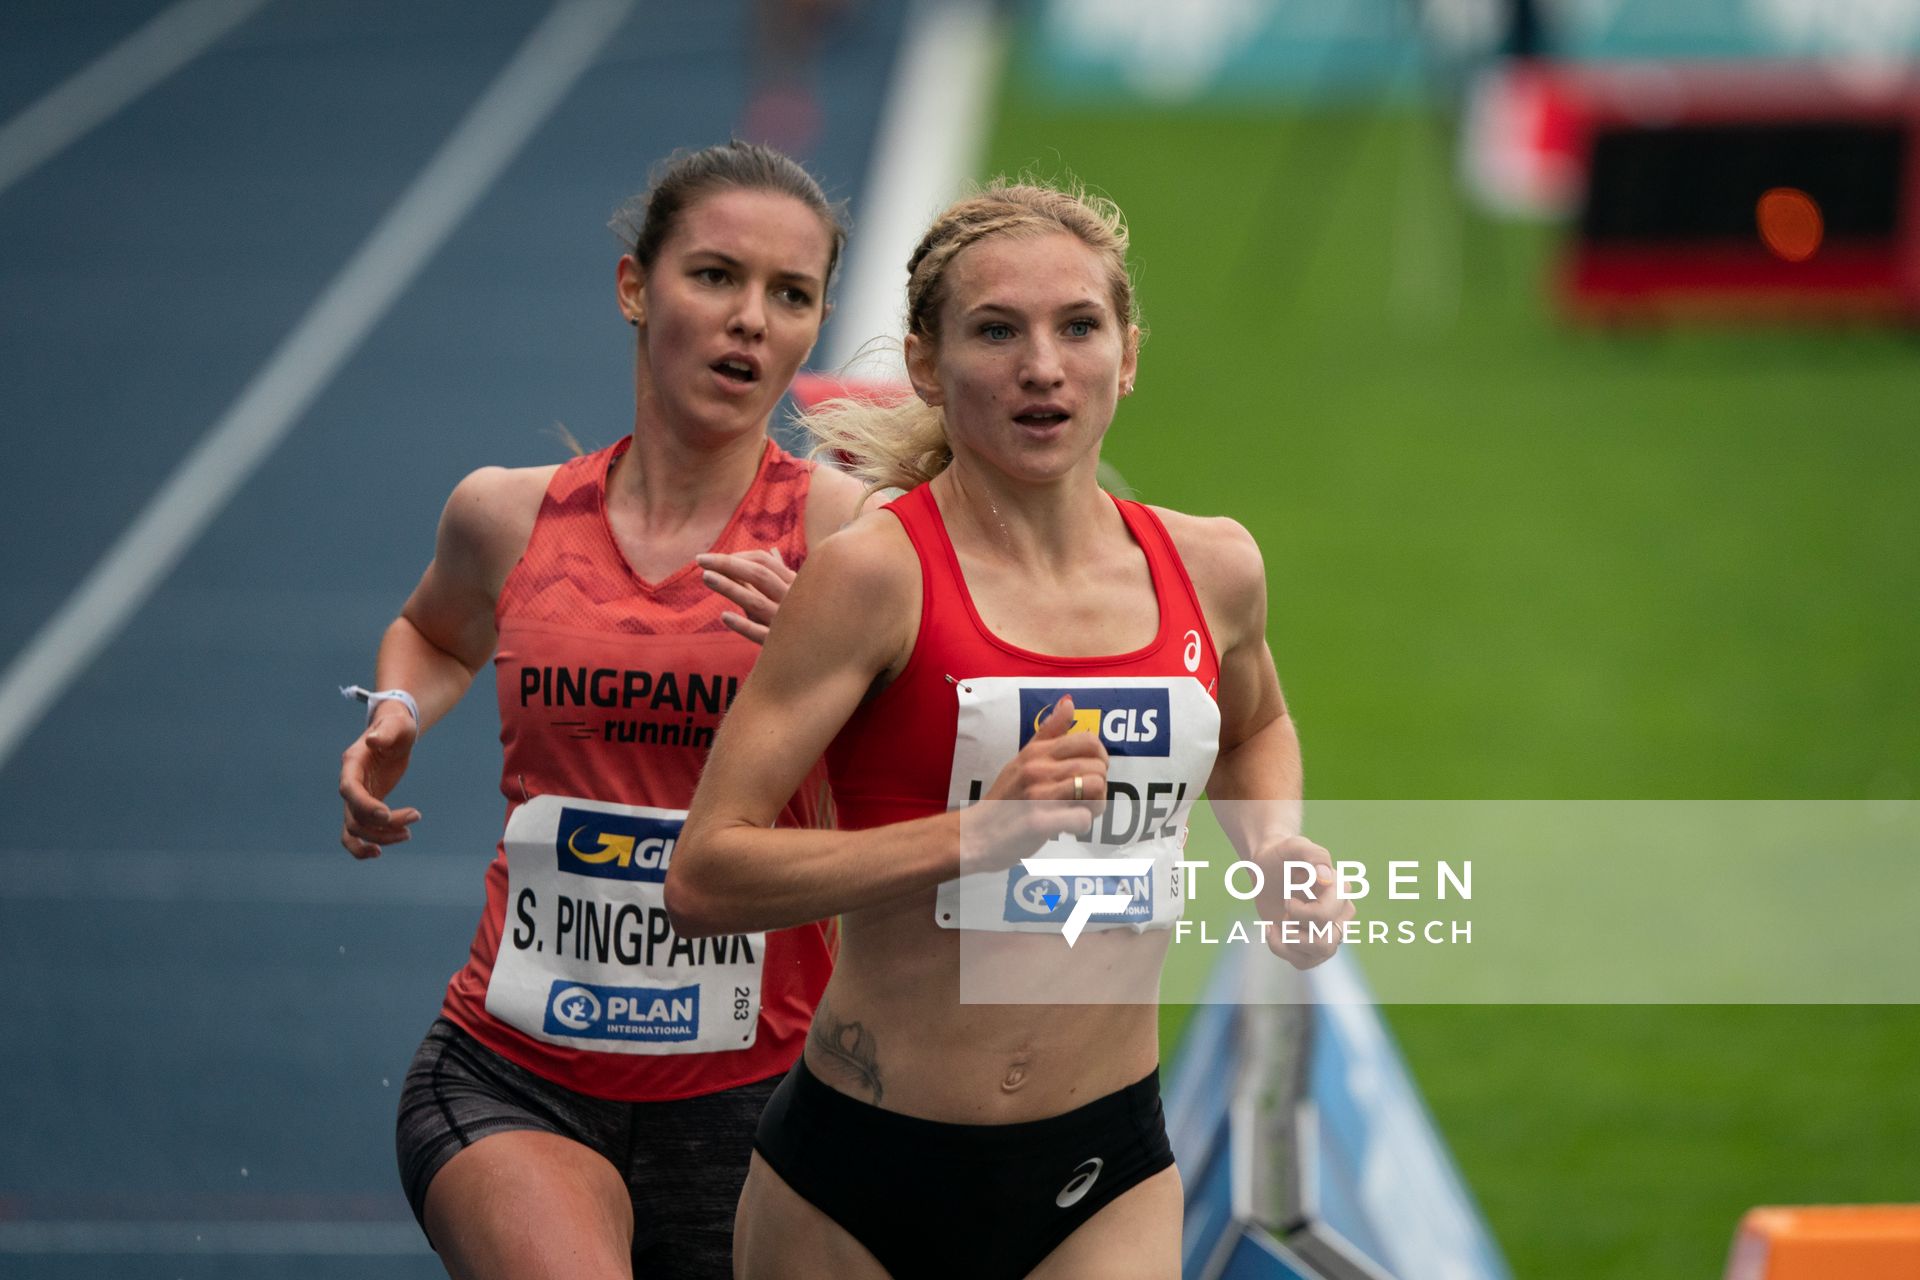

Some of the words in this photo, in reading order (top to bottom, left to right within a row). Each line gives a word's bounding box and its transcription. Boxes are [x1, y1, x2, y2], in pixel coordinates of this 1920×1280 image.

[604, 716, 715, 749] runnin
[1102, 709, 1158, 742] GLS
[634, 837, 675, 870] GL
[512, 887, 544, 953] S.
[607, 995, 693, 1023] PLAN
[733, 987, 750, 1022] 263
[607, 1024, 692, 1035] INTERNATIONAL
